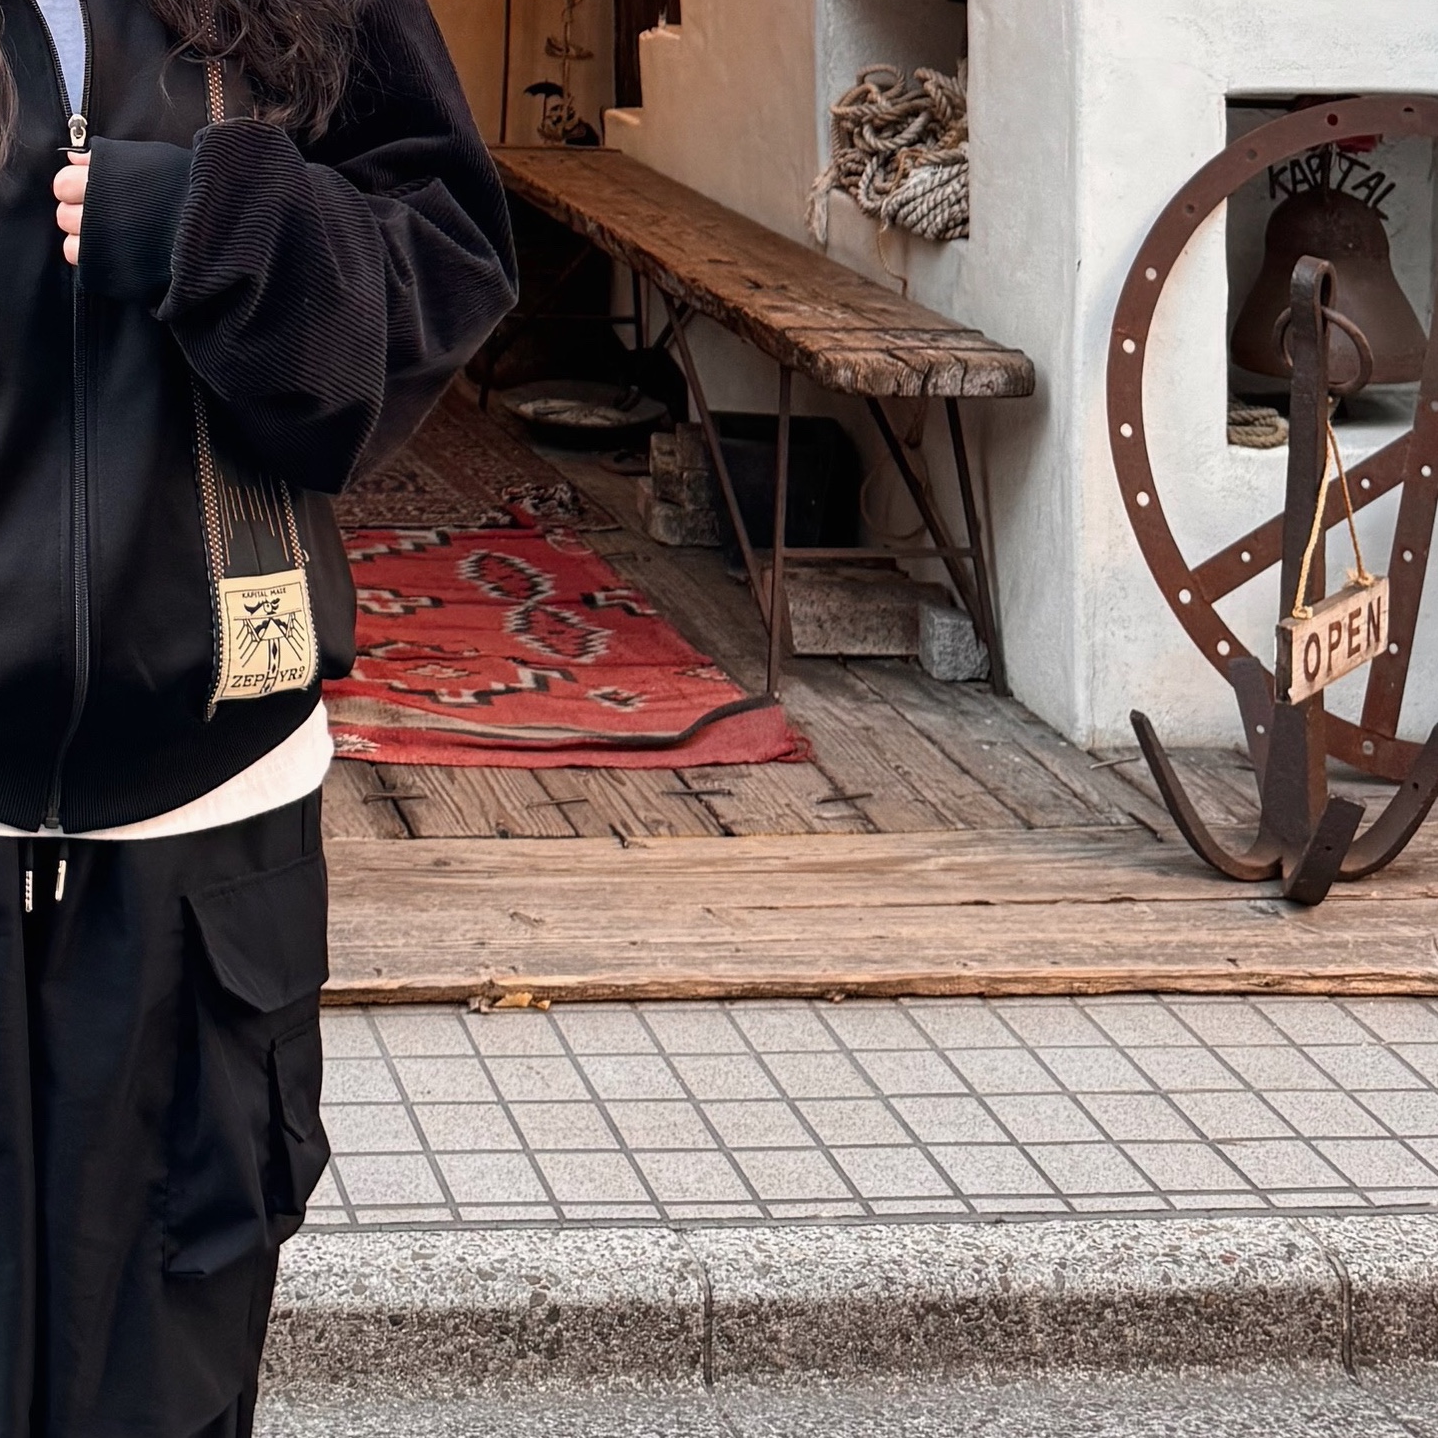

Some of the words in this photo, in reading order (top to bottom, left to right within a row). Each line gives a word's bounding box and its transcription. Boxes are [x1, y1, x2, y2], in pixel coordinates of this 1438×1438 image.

[1267, 150, 1396, 221] KAPTAL
[241, 589, 268, 599] KAPITAL
[1303, 596, 1381, 682] OPEN
